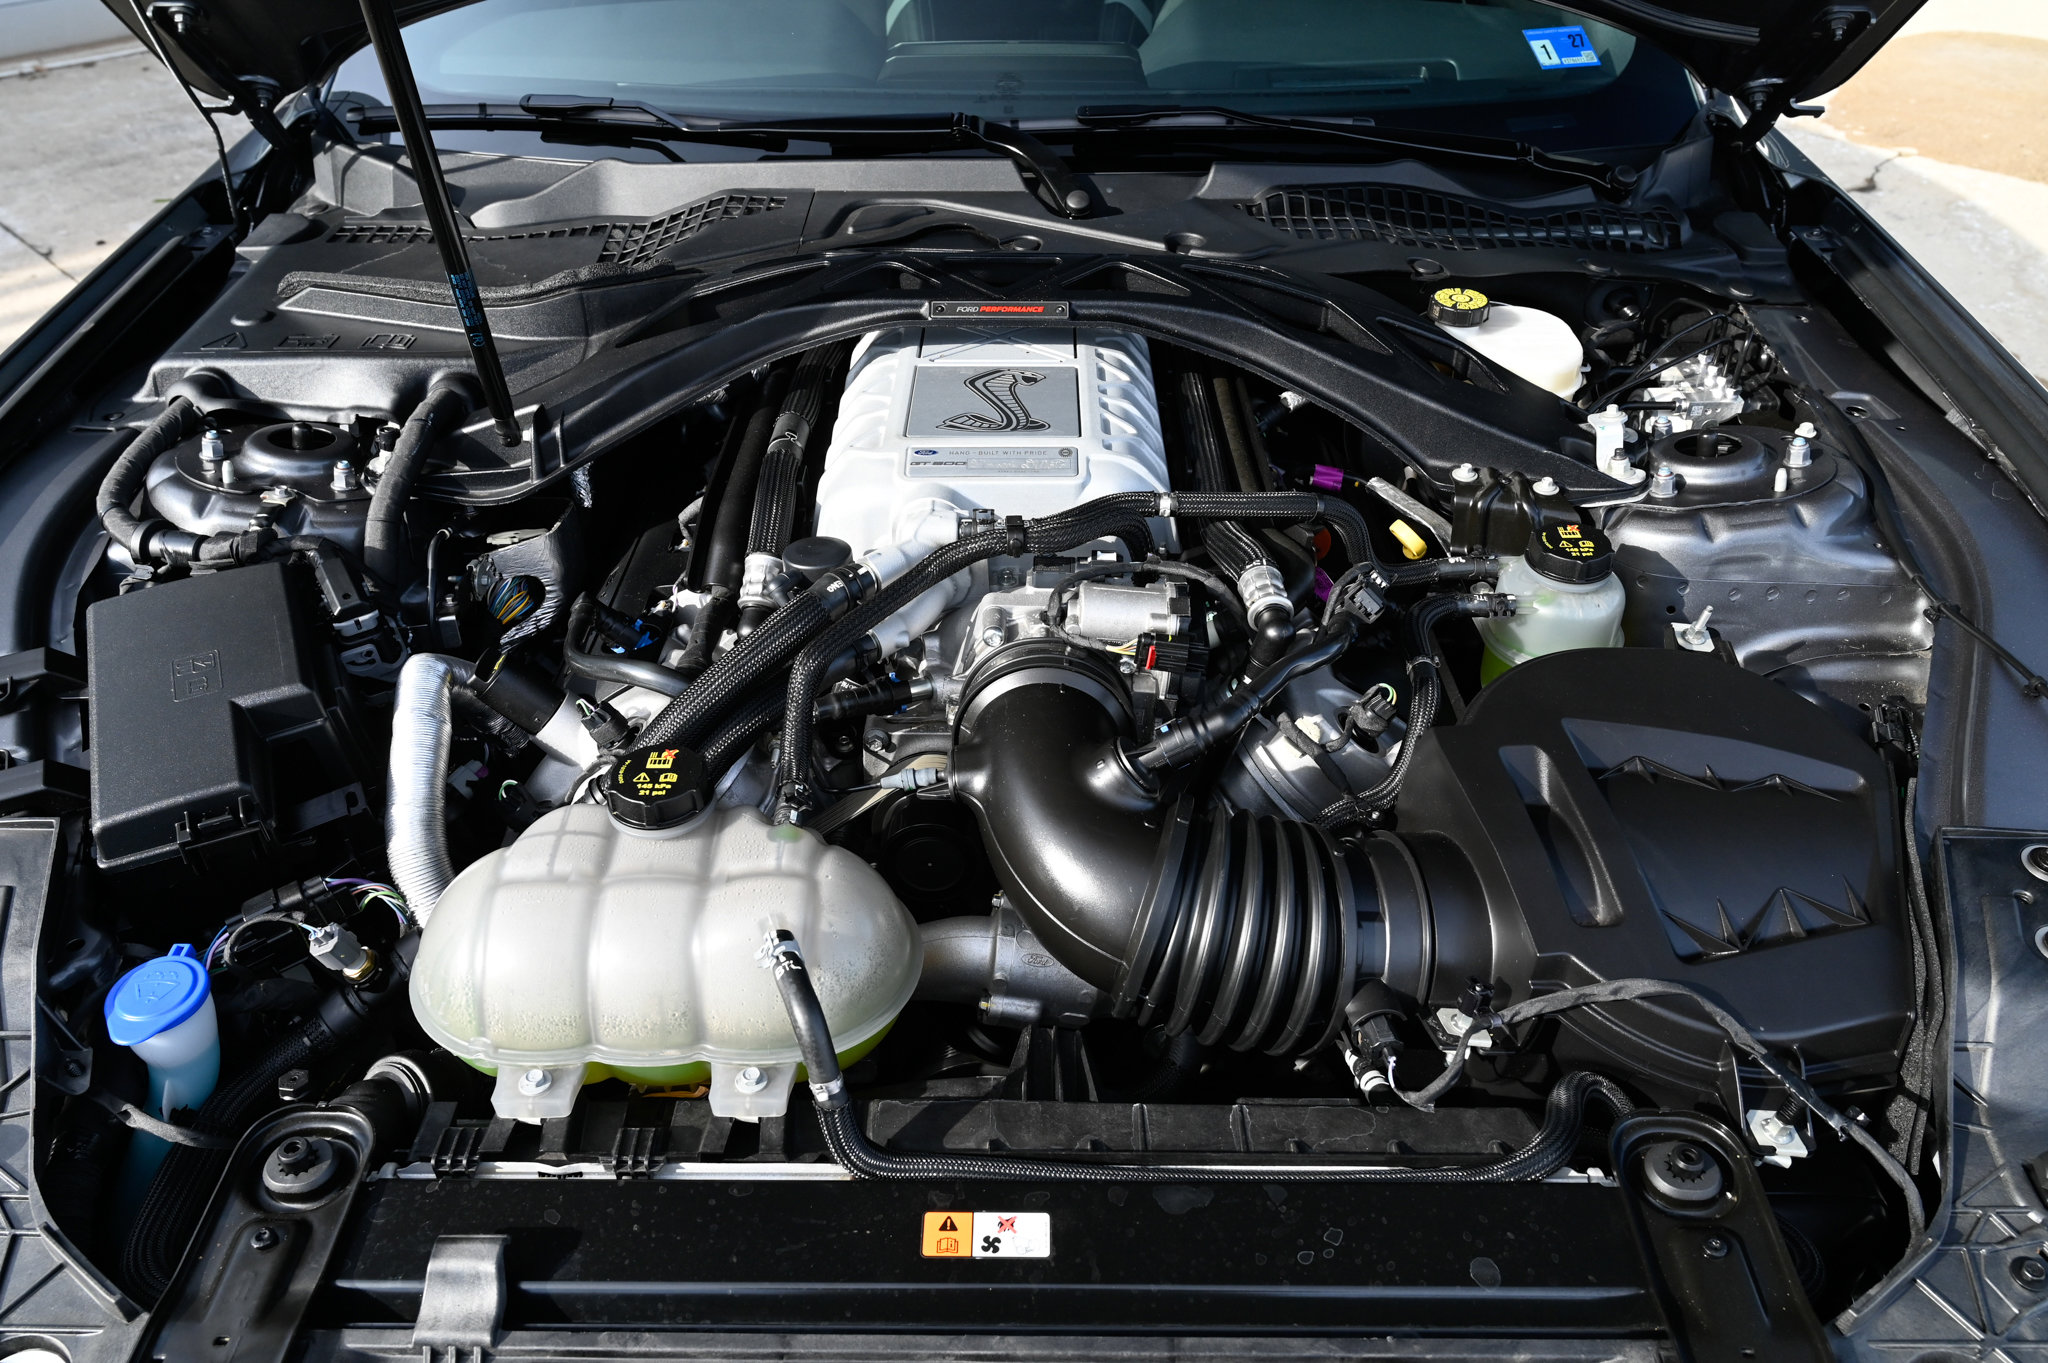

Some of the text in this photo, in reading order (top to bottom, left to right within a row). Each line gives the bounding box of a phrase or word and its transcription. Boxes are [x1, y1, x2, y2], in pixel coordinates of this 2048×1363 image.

[1567, 33, 1585, 48] 27
[1540, 44, 1552, 60] 1
[651, 789, 667, 797] psi
